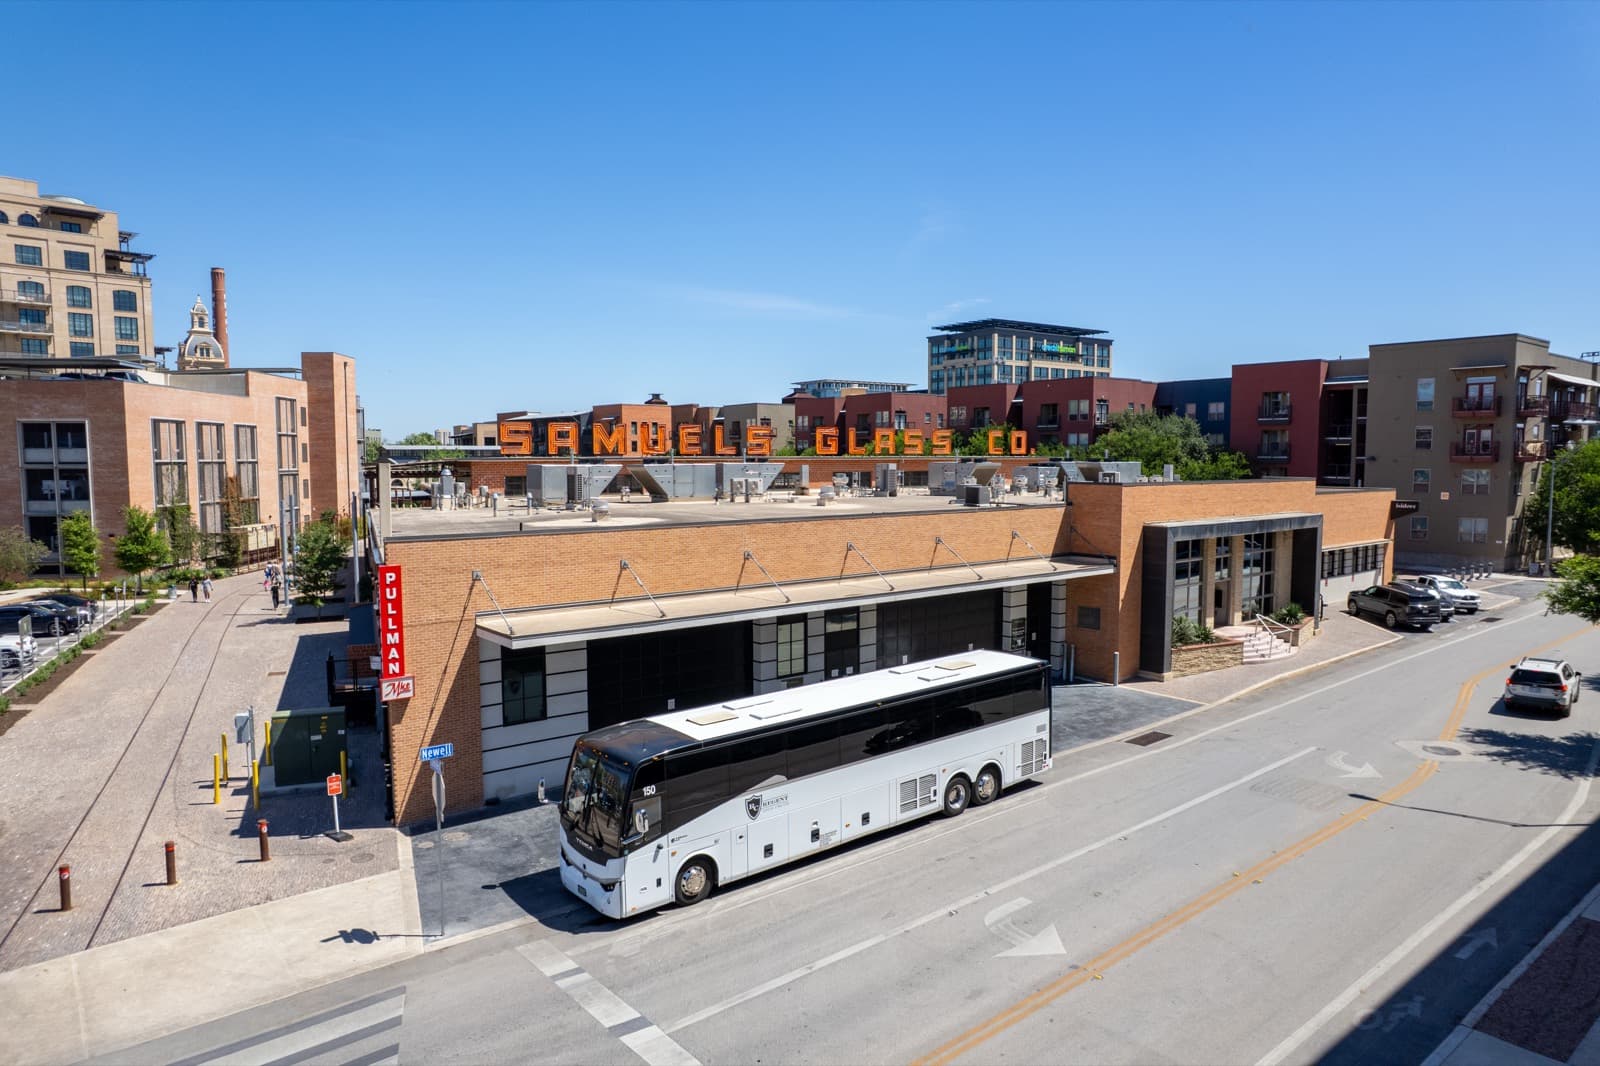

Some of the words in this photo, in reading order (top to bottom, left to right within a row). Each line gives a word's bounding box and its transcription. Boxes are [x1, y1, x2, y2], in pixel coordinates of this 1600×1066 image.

[499, 421, 773, 457] SAMUELS
[815, 426, 953, 456] GLASS
[384, 572, 401, 675] PULLMAN
[421, 744, 453, 761] Newell
[642, 784, 656, 797] 150
